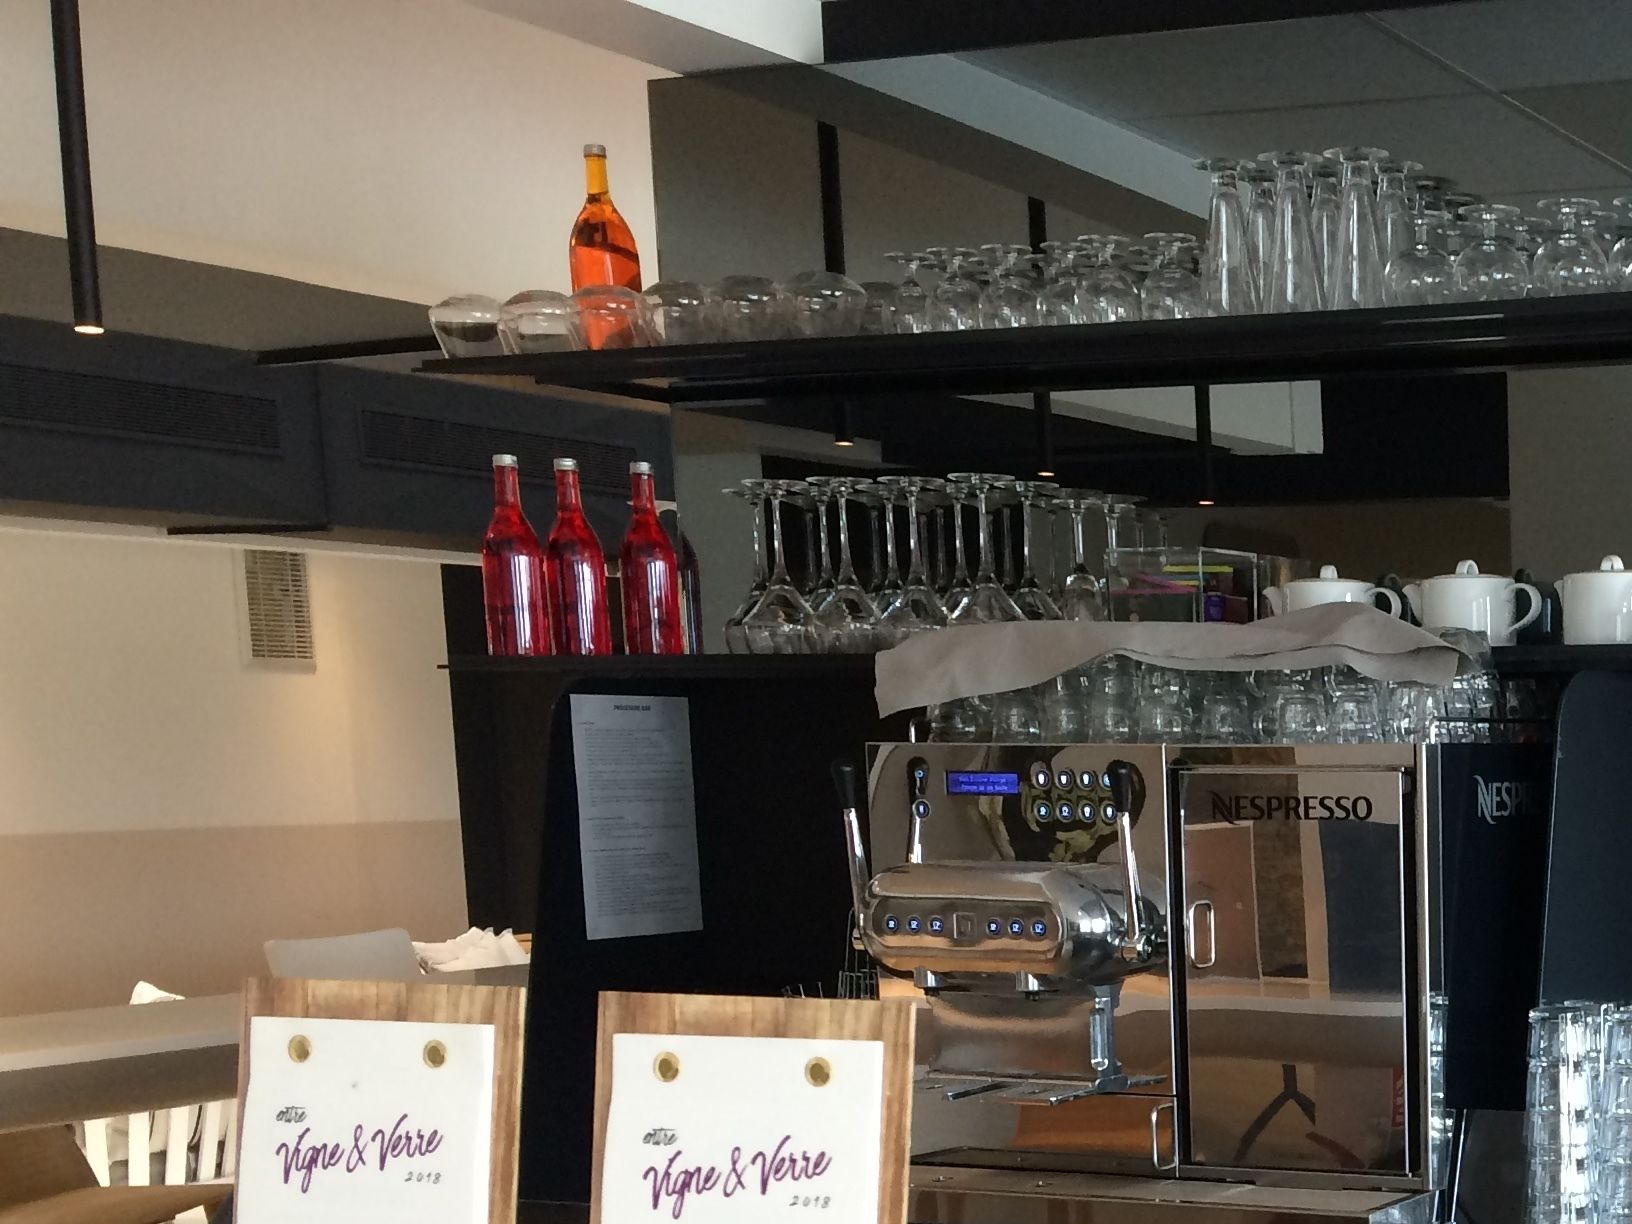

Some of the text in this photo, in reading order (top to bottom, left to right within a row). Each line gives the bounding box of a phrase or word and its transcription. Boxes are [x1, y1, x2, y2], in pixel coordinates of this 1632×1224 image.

[1210, 790, 1373, 825] NESPRESSO
[275, 1113, 444, 1194] Vigne & Verre
[404, 1171, 442, 1184] 2018
[643, 1135, 833, 1220] Vigne & Verre
[789, 1195, 831, 1209] 2018
